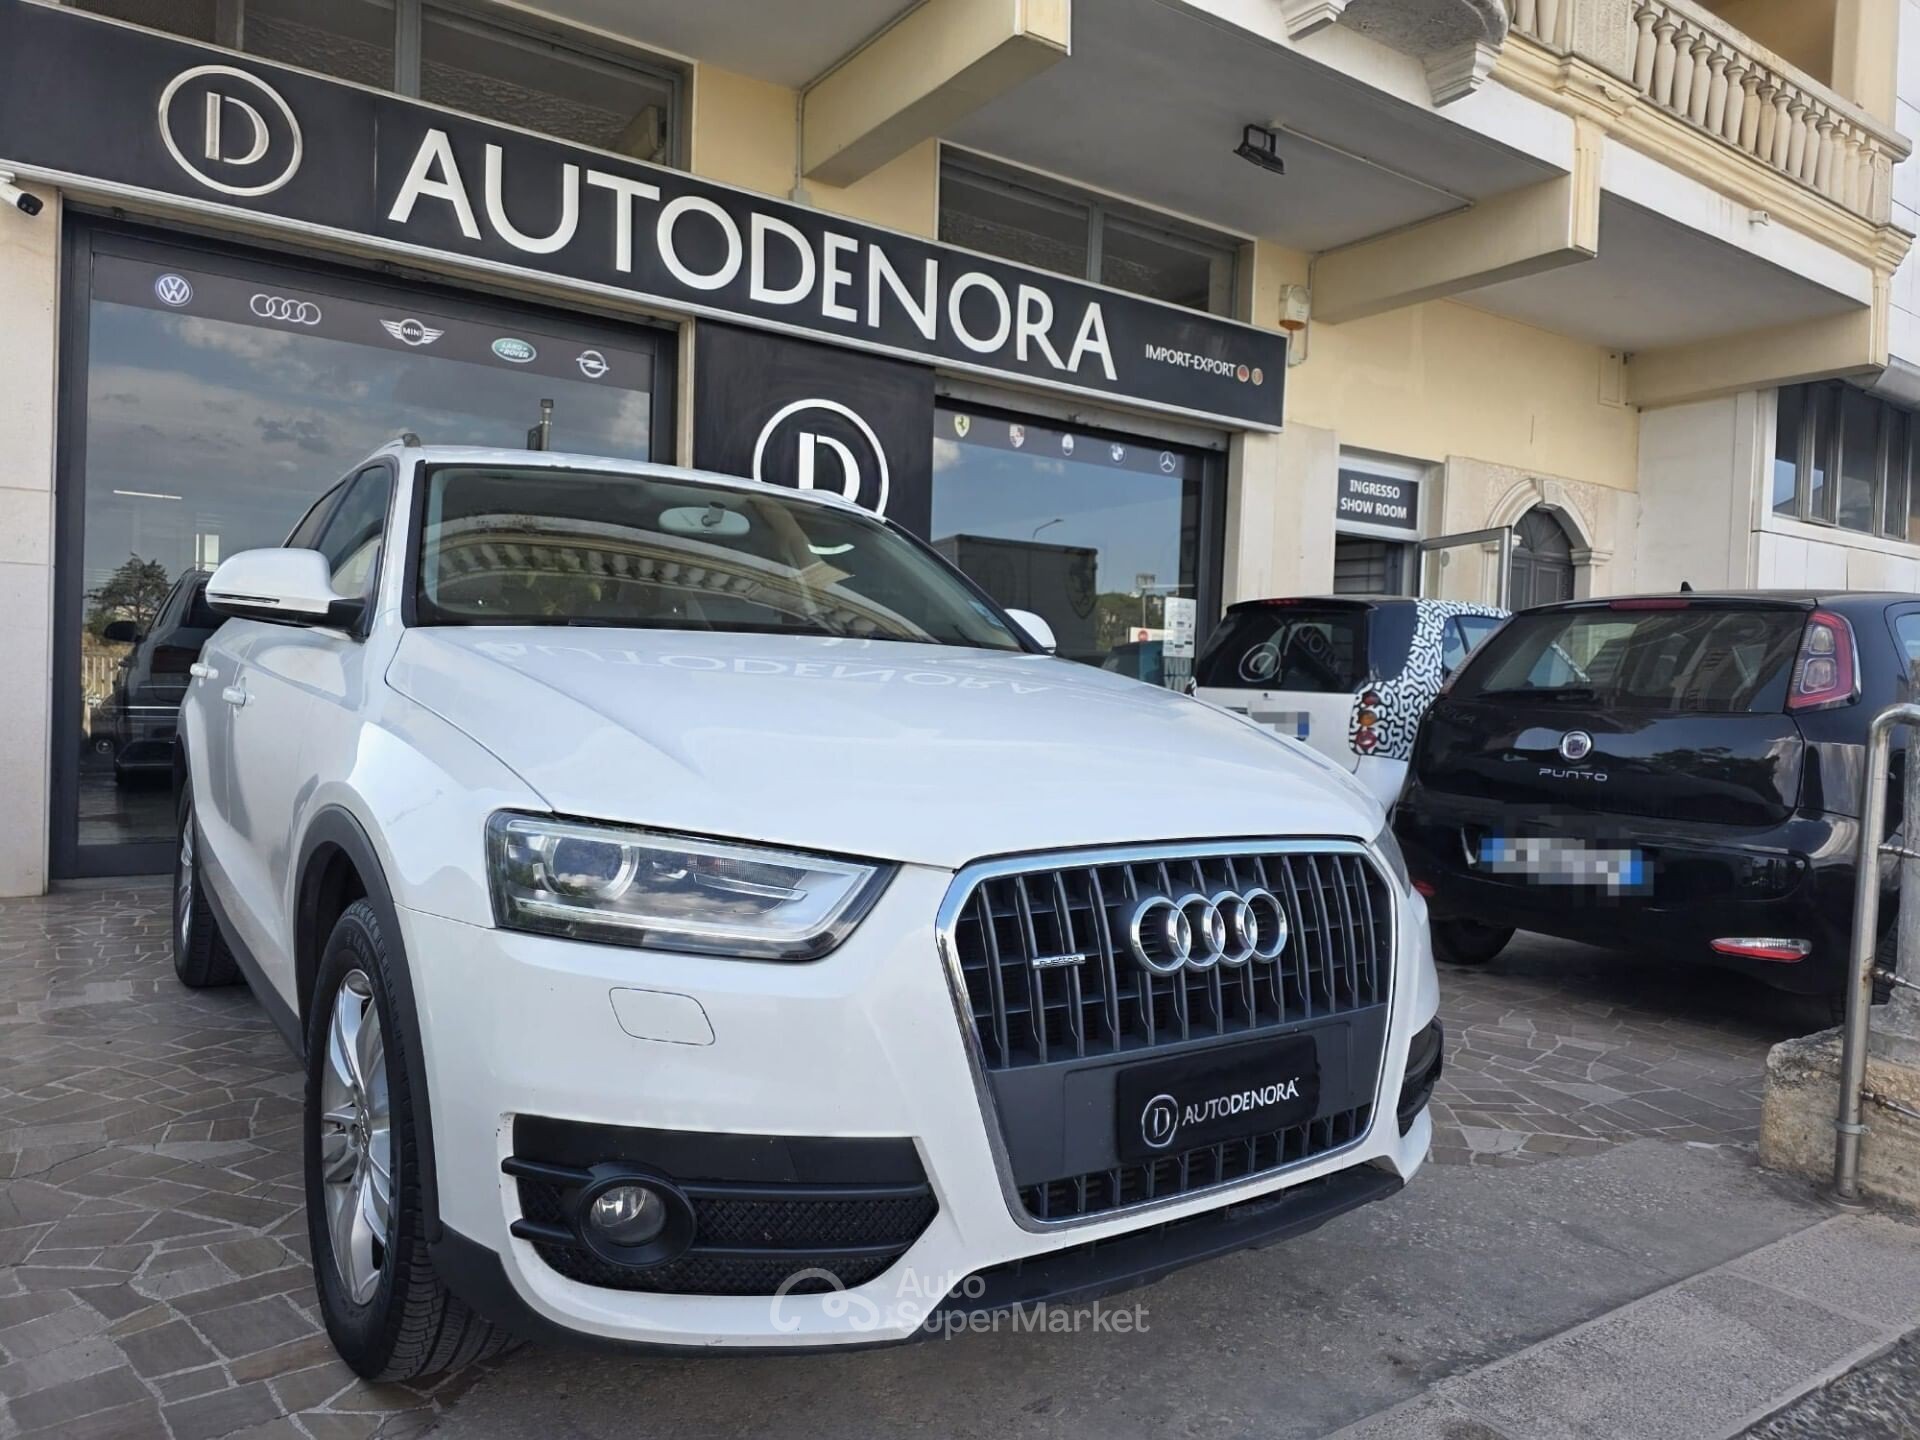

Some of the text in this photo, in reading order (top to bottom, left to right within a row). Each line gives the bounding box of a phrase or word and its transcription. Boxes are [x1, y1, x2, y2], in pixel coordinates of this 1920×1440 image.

[388, 128, 1119, 381] AUTODENORA
[402, 327, 422, 337] MINI
[503, 348, 529, 359] ROVER
[1145, 343, 1236, 378] IMPORT-EXPORT
[1349, 479, 1400, 499] INGRESSO
[1340, 497, 1407, 519] SHOW ROOM
[1538, 767, 1608, 782] PUNTO
[1182, 1077, 1300, 1127] AUTODENORA
